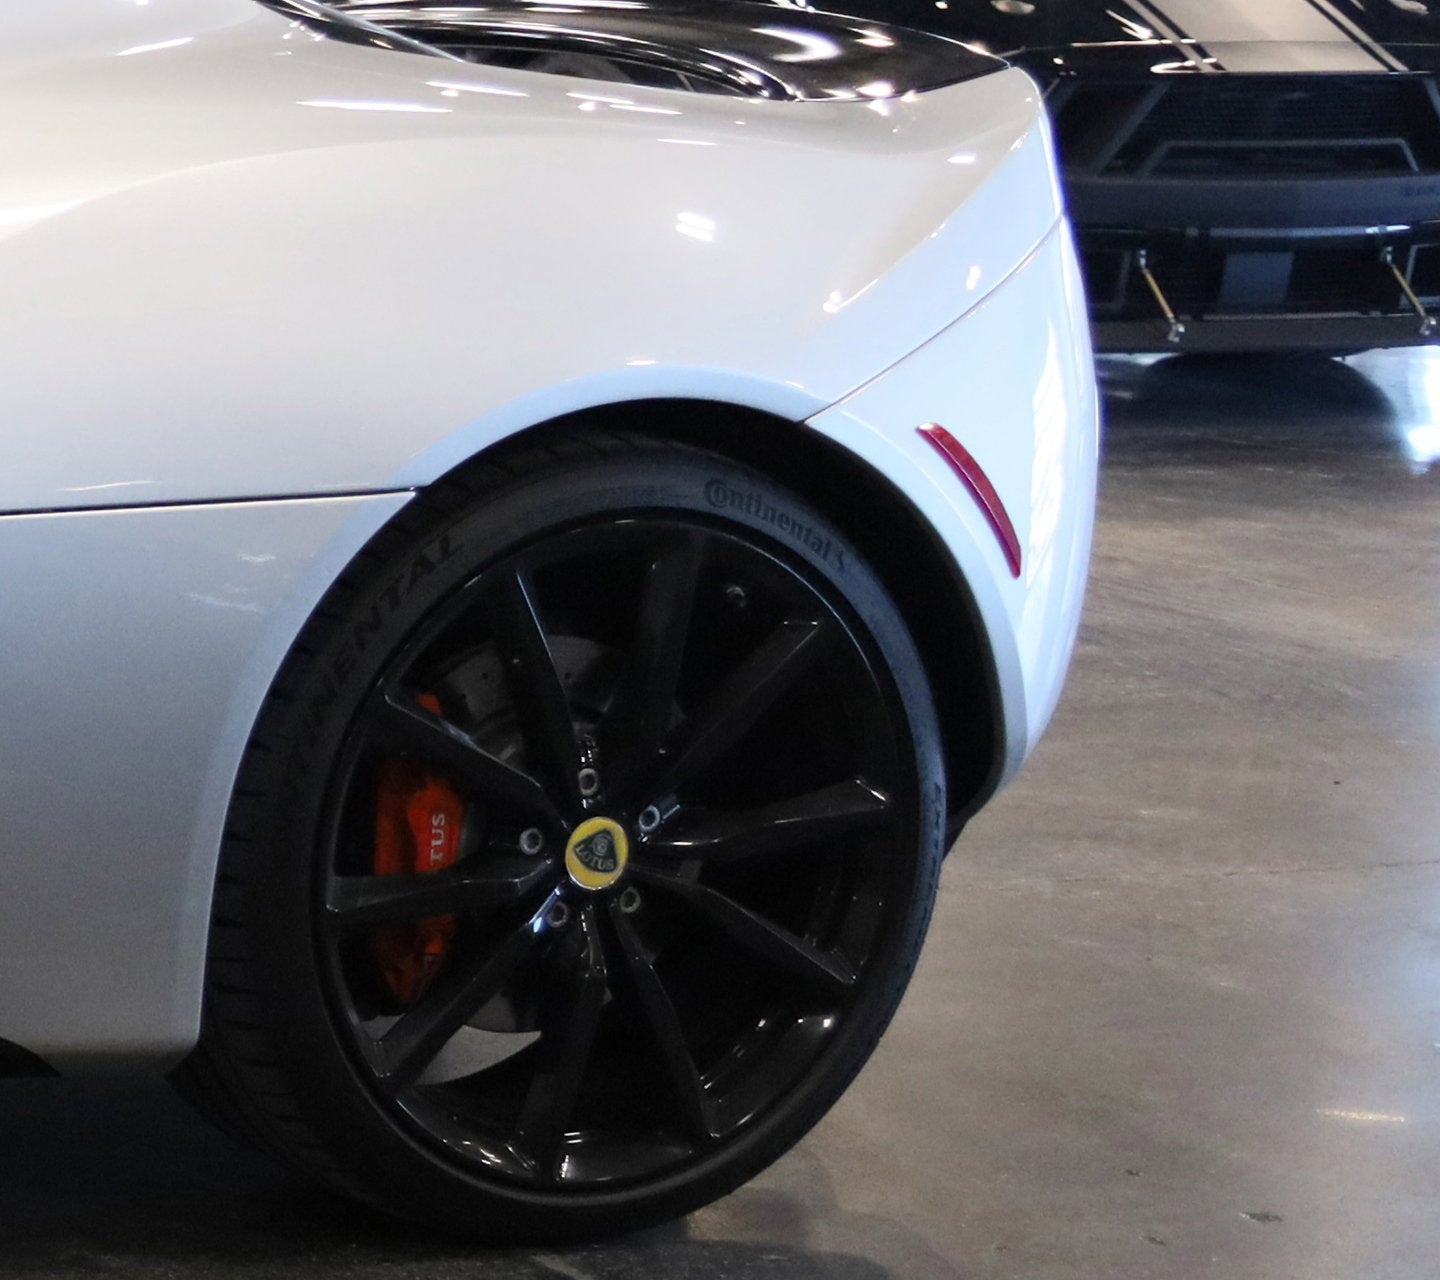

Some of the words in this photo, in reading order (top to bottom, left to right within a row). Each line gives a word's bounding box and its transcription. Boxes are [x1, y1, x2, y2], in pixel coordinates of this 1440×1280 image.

[705, 479, 835, 562] Continental
[430, 813, 446, 862] TUS
[575, 844, 615, 871] LOTUS
